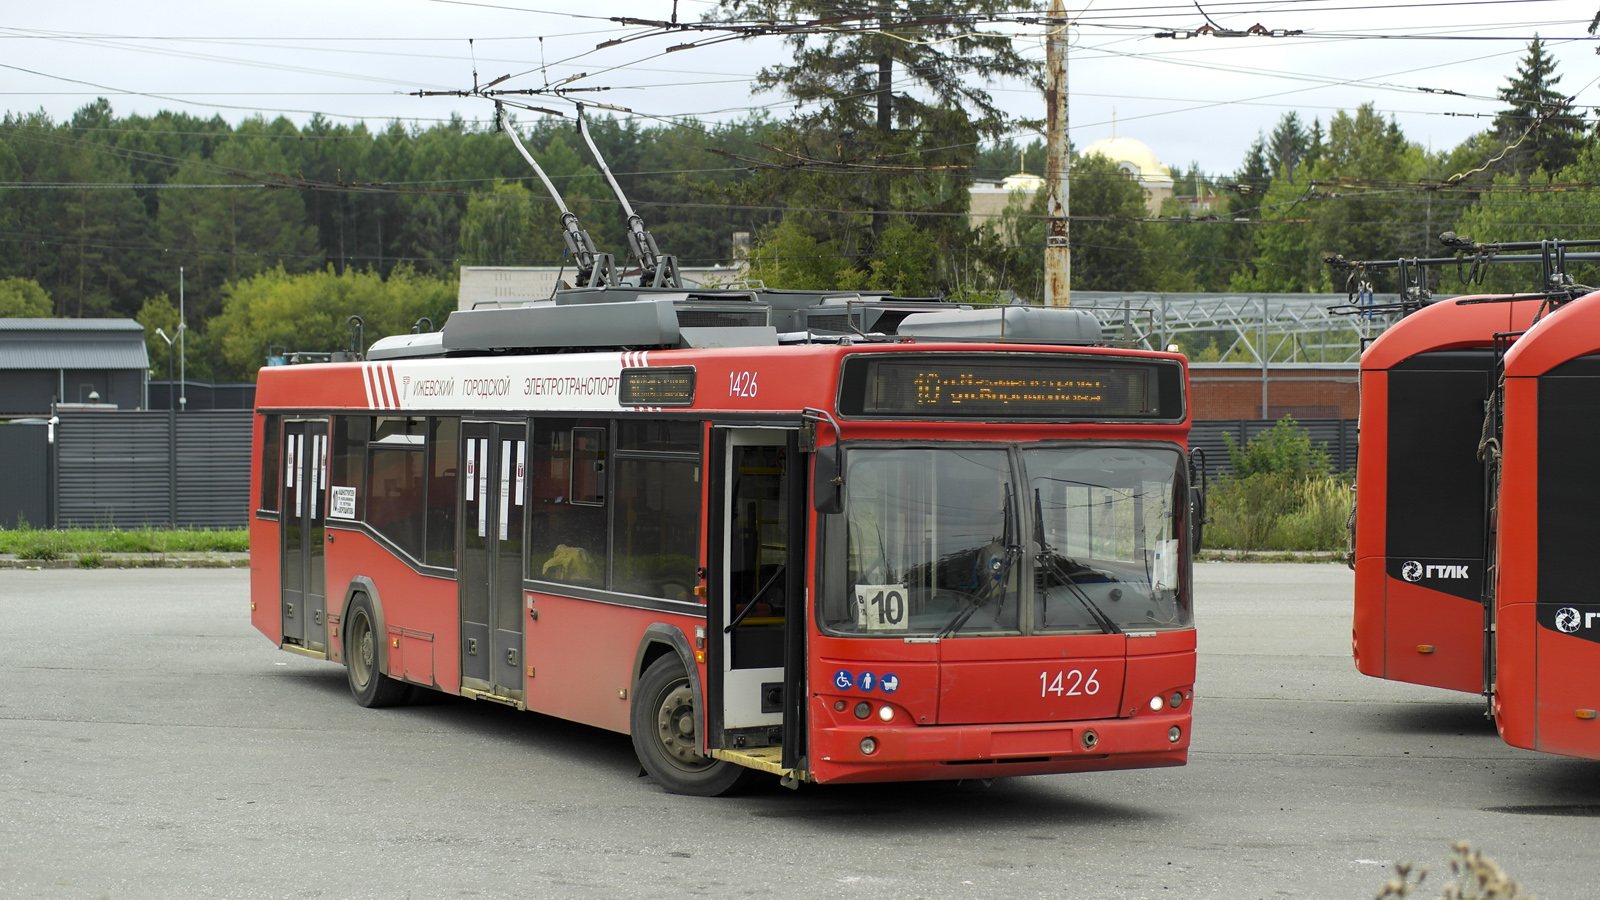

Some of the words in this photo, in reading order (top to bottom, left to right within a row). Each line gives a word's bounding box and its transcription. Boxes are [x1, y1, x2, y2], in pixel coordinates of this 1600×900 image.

[413, 376, 454, 396] ИЖЕВСКИЙ
[463, 375, 510, 399] ГОРОДСКОЙ
[524, 376, 620, 396] ЭЛЕКТРОТРАНСПОРТ
[729, 371, 757, 397] 1426
[1426, 564, 1469, 579] ГТЛК
[871, 590, 904, 625] 10
[1040, 668, 1100, 697] 1426
